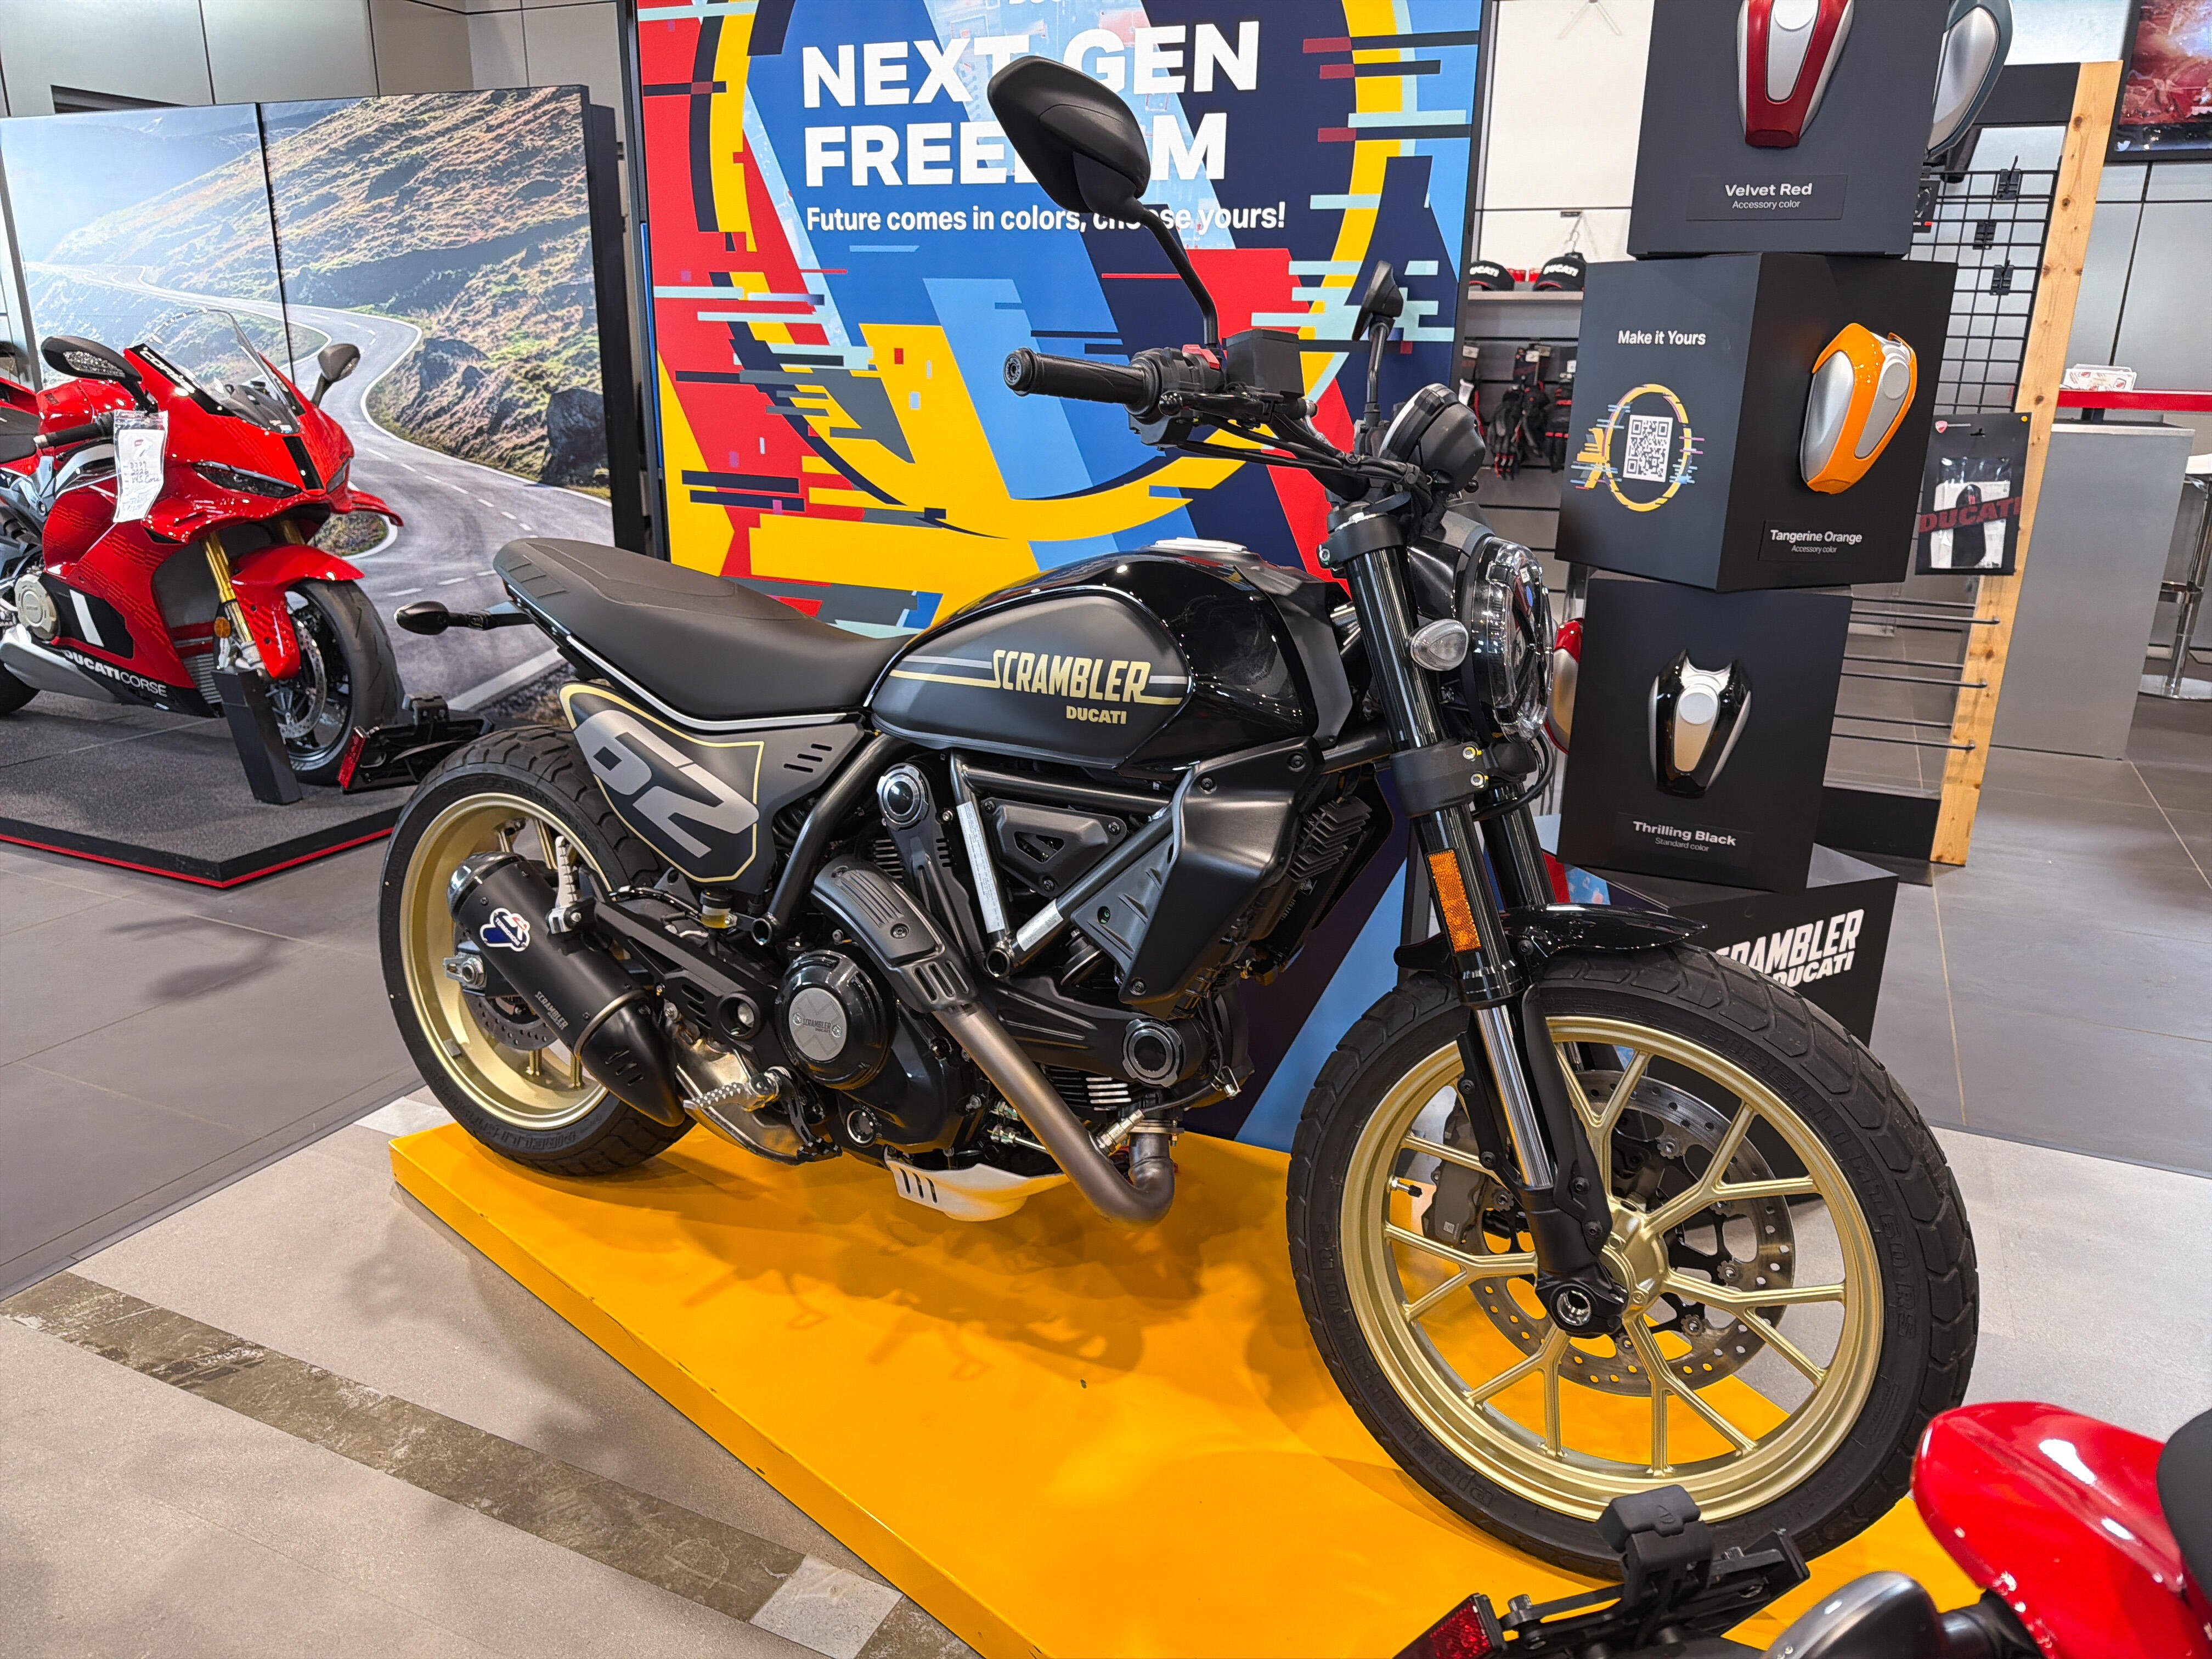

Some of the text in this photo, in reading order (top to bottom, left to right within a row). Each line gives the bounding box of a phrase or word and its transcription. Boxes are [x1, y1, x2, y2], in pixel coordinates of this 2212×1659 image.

[802, 21, 1260, 108] NEXT GEN
[805, 112, 1228, 187] FREEM
[1725, 183, 1813, 196] Velvet Red
[1732, 199, 1801, 210] Accessory color
[807, 201, 1286, 235] Future comes in colors, cse yours!
[1618, 330, 1706, 346] Make it Yours
[1919, 496, 2023, 533] DUCATI
[1770, 529, 1863, 545] Tangerine Orange
[1791, 544, 1838, 555] Accessory color
[993, 649, 1152, 704] SCRAMBLER
[1066, 705, 1127, 725] DUCATI
[1633, 821, 1737, 847] Thrilling Black
[1655, 837, 1710, 852] Standard color
[1716, 908, 1865, 975] RAMBLER
[1773, 950, 1855, 988] DUCATI
